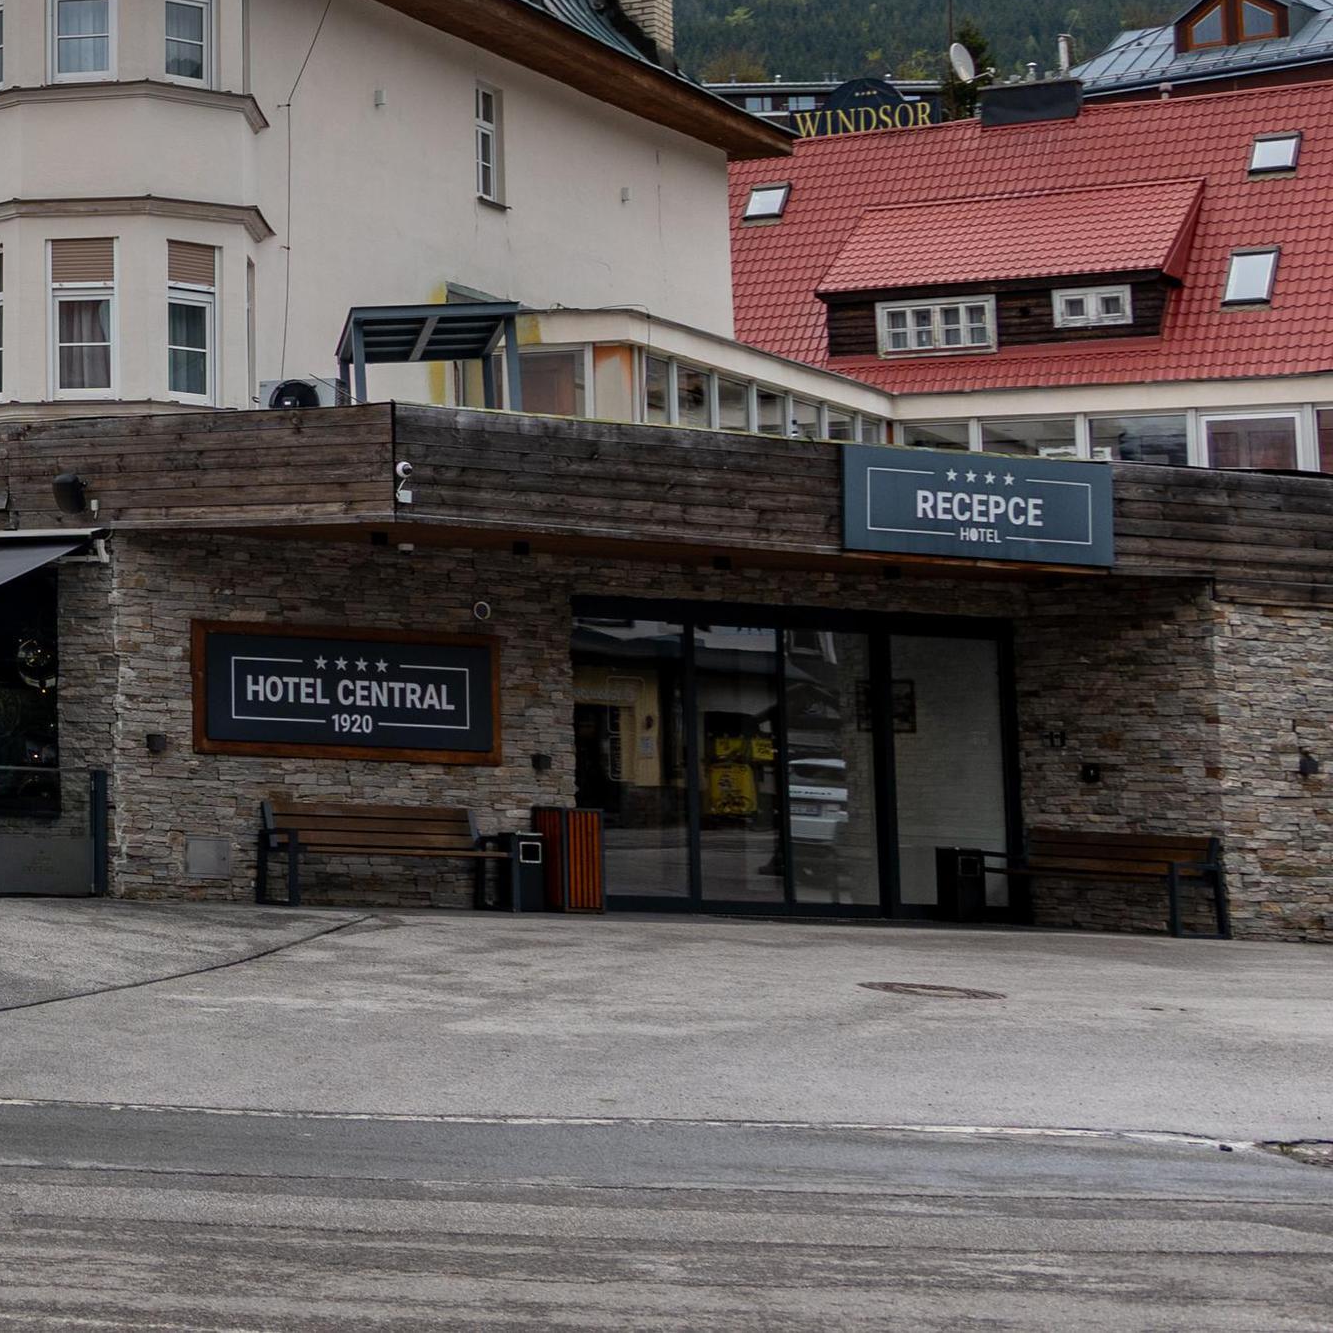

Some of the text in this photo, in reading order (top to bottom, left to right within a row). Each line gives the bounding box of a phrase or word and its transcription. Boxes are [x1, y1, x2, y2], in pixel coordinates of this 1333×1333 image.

[795, 102, 933, 138] WINDSOR
[916, 489, 1044, 527] RECEPCE
[960, 527, 1002, 543] HOTEL
[246, 675, 455, 710] HOTEL CENTRAL
[331, 713, 373, 733] 1920
